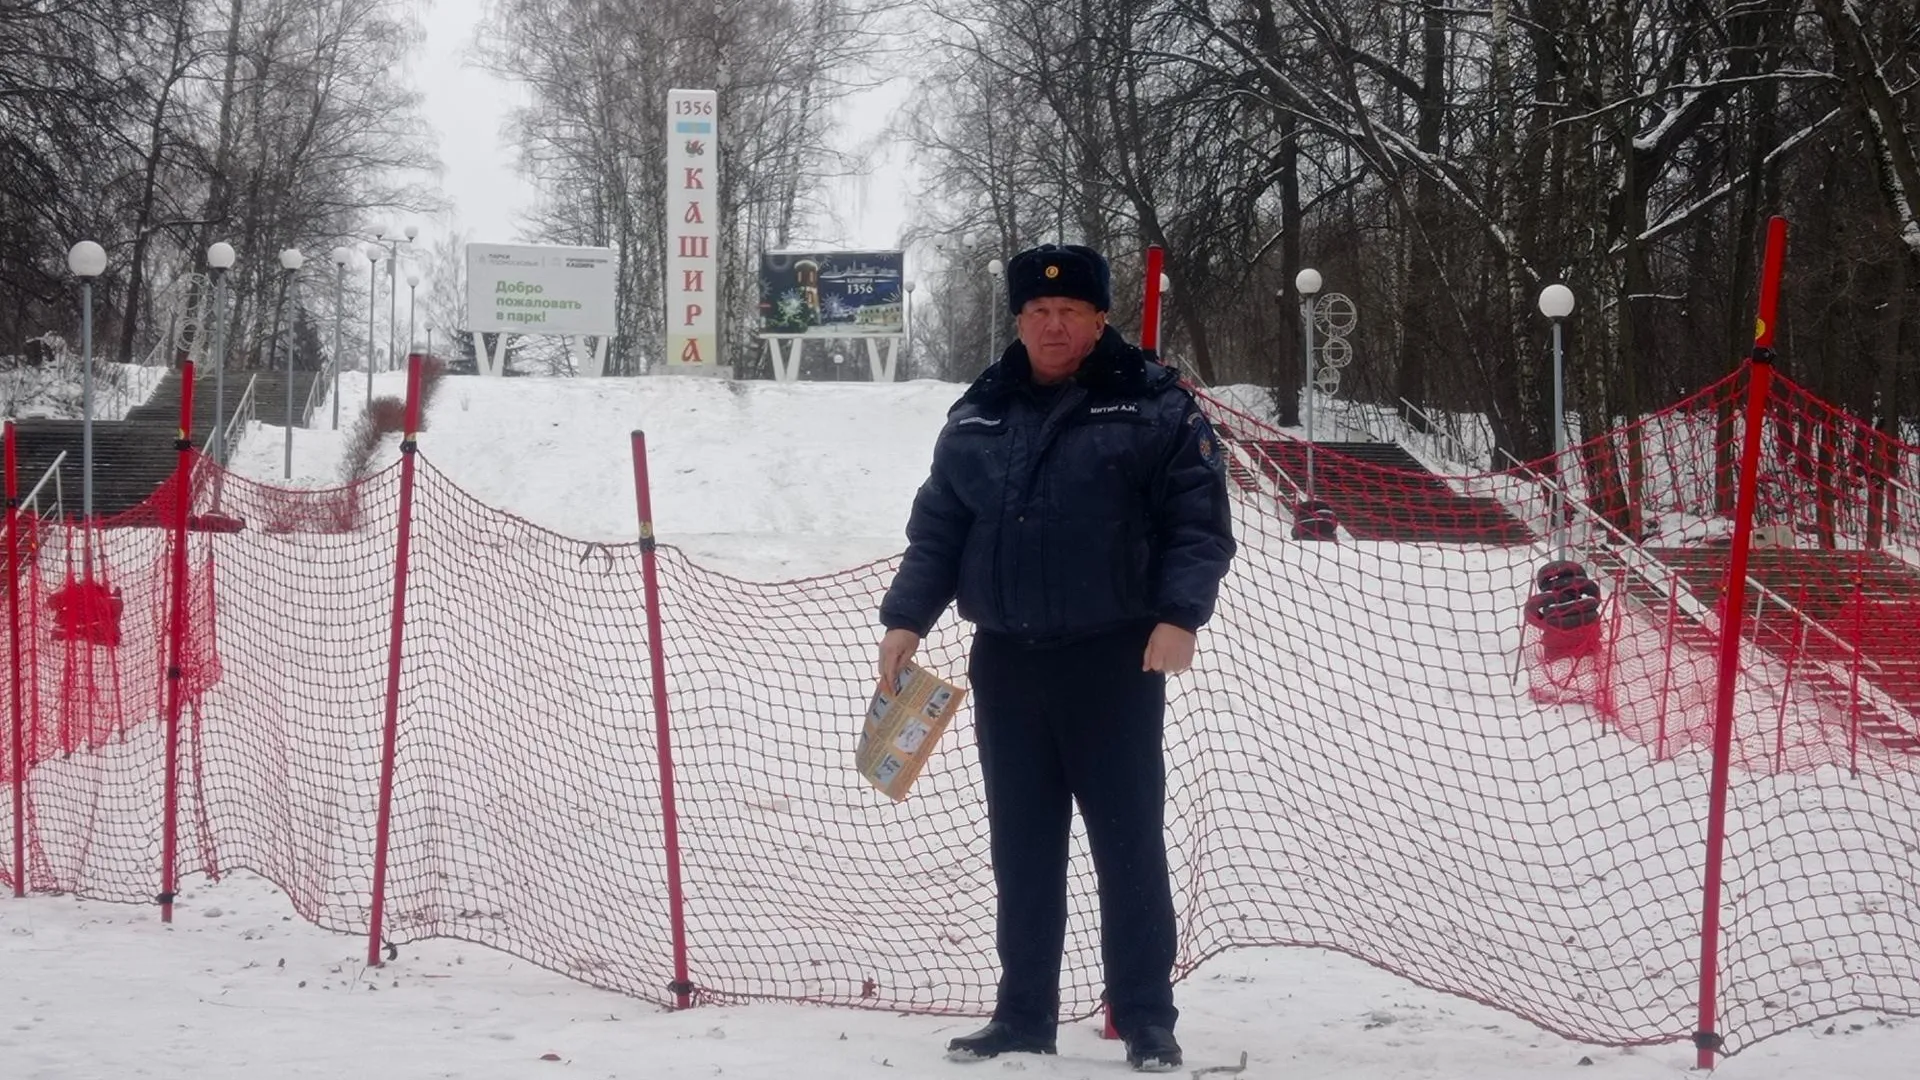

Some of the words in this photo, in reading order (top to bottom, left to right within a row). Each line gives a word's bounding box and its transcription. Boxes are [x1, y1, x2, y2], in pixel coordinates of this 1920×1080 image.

[675, 101, 712, 115] 1356
[678, 167, 709, 362] КАШИРА
[496, 281, 543, 295] Добро
[848, 284, 873, 294] 1356
[496, 297, 582, 310] пожаловать
[496, 311, 505, 321] в
[507, 311, 546, 324] парк!
